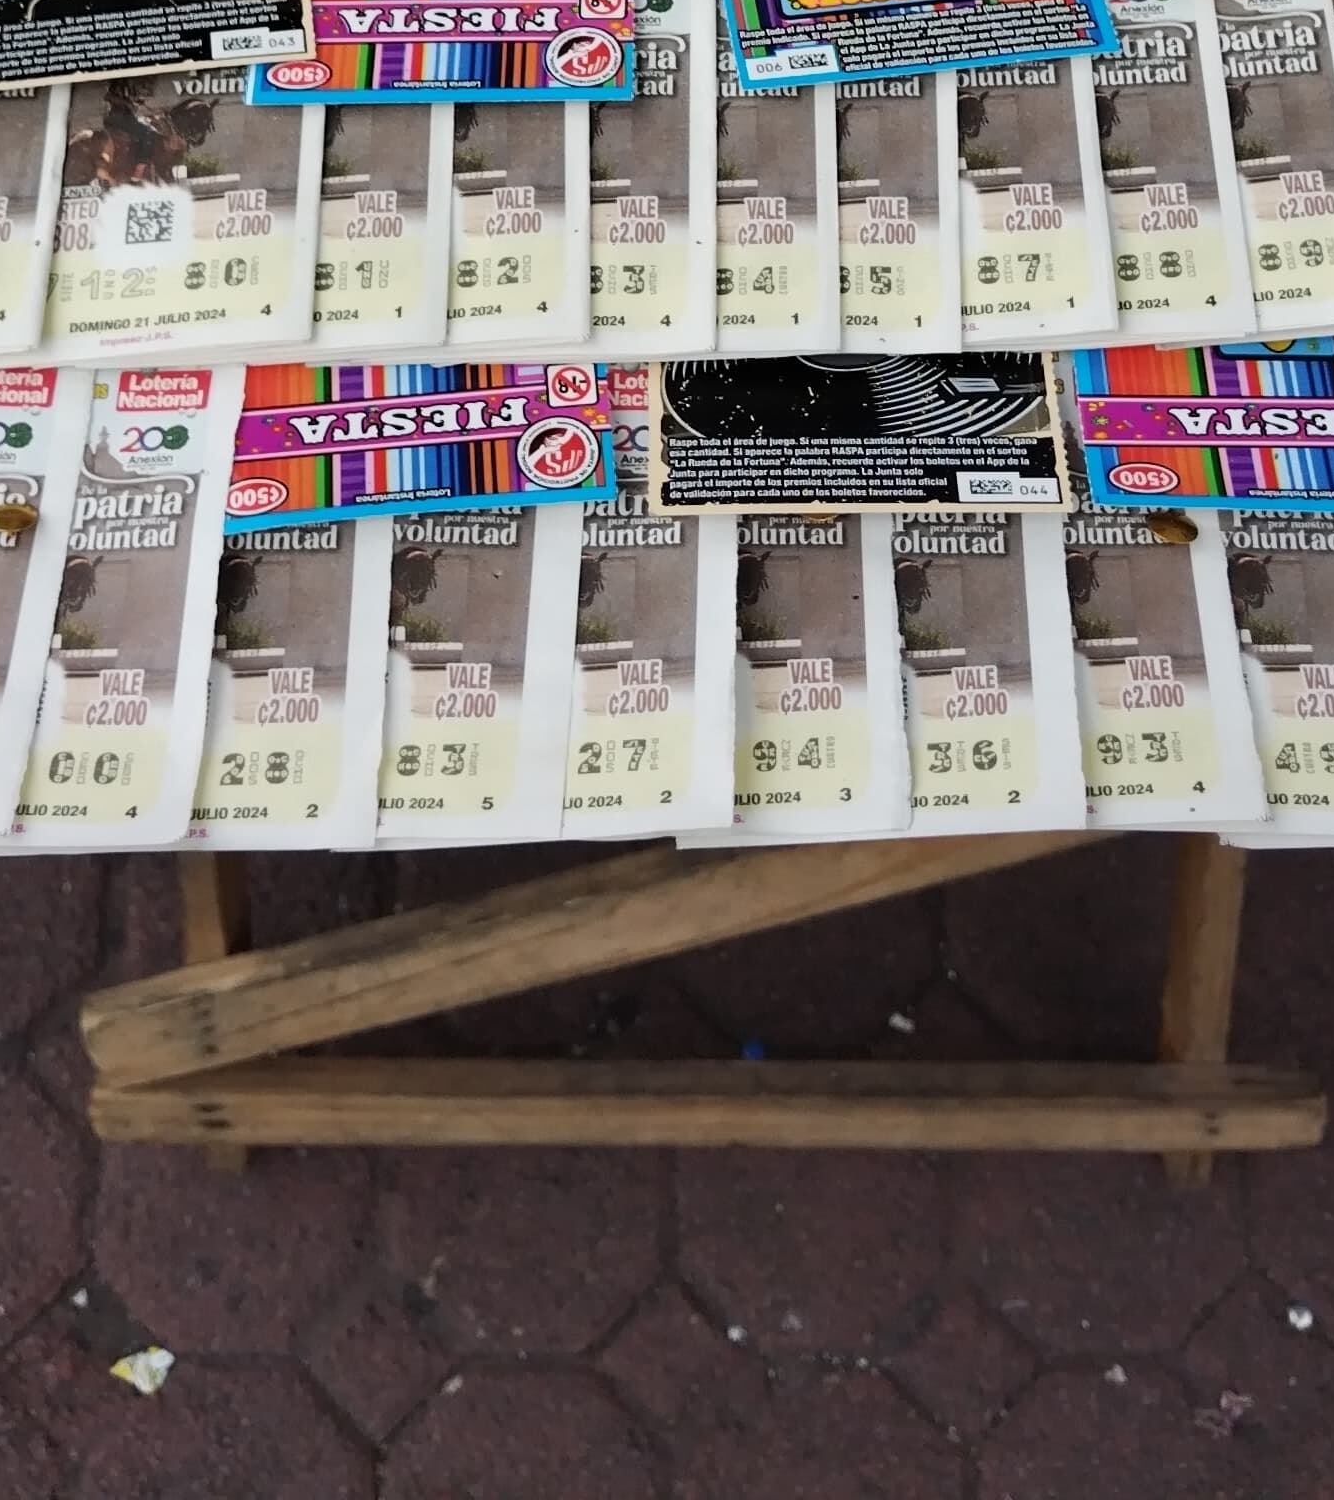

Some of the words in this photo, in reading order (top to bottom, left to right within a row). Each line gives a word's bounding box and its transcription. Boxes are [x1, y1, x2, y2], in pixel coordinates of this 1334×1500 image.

[339, 7, 565, 35] FIESTA
[495, 188, 533, 210] VALE
[69, 316, 132, 334] DOMINGO
[137, 315, 152, 328] 21
[155, 311, 192, 326] JULIO
[194, 308, 226, 323] 2024
[289, 397, 529, 445] FIESTA
